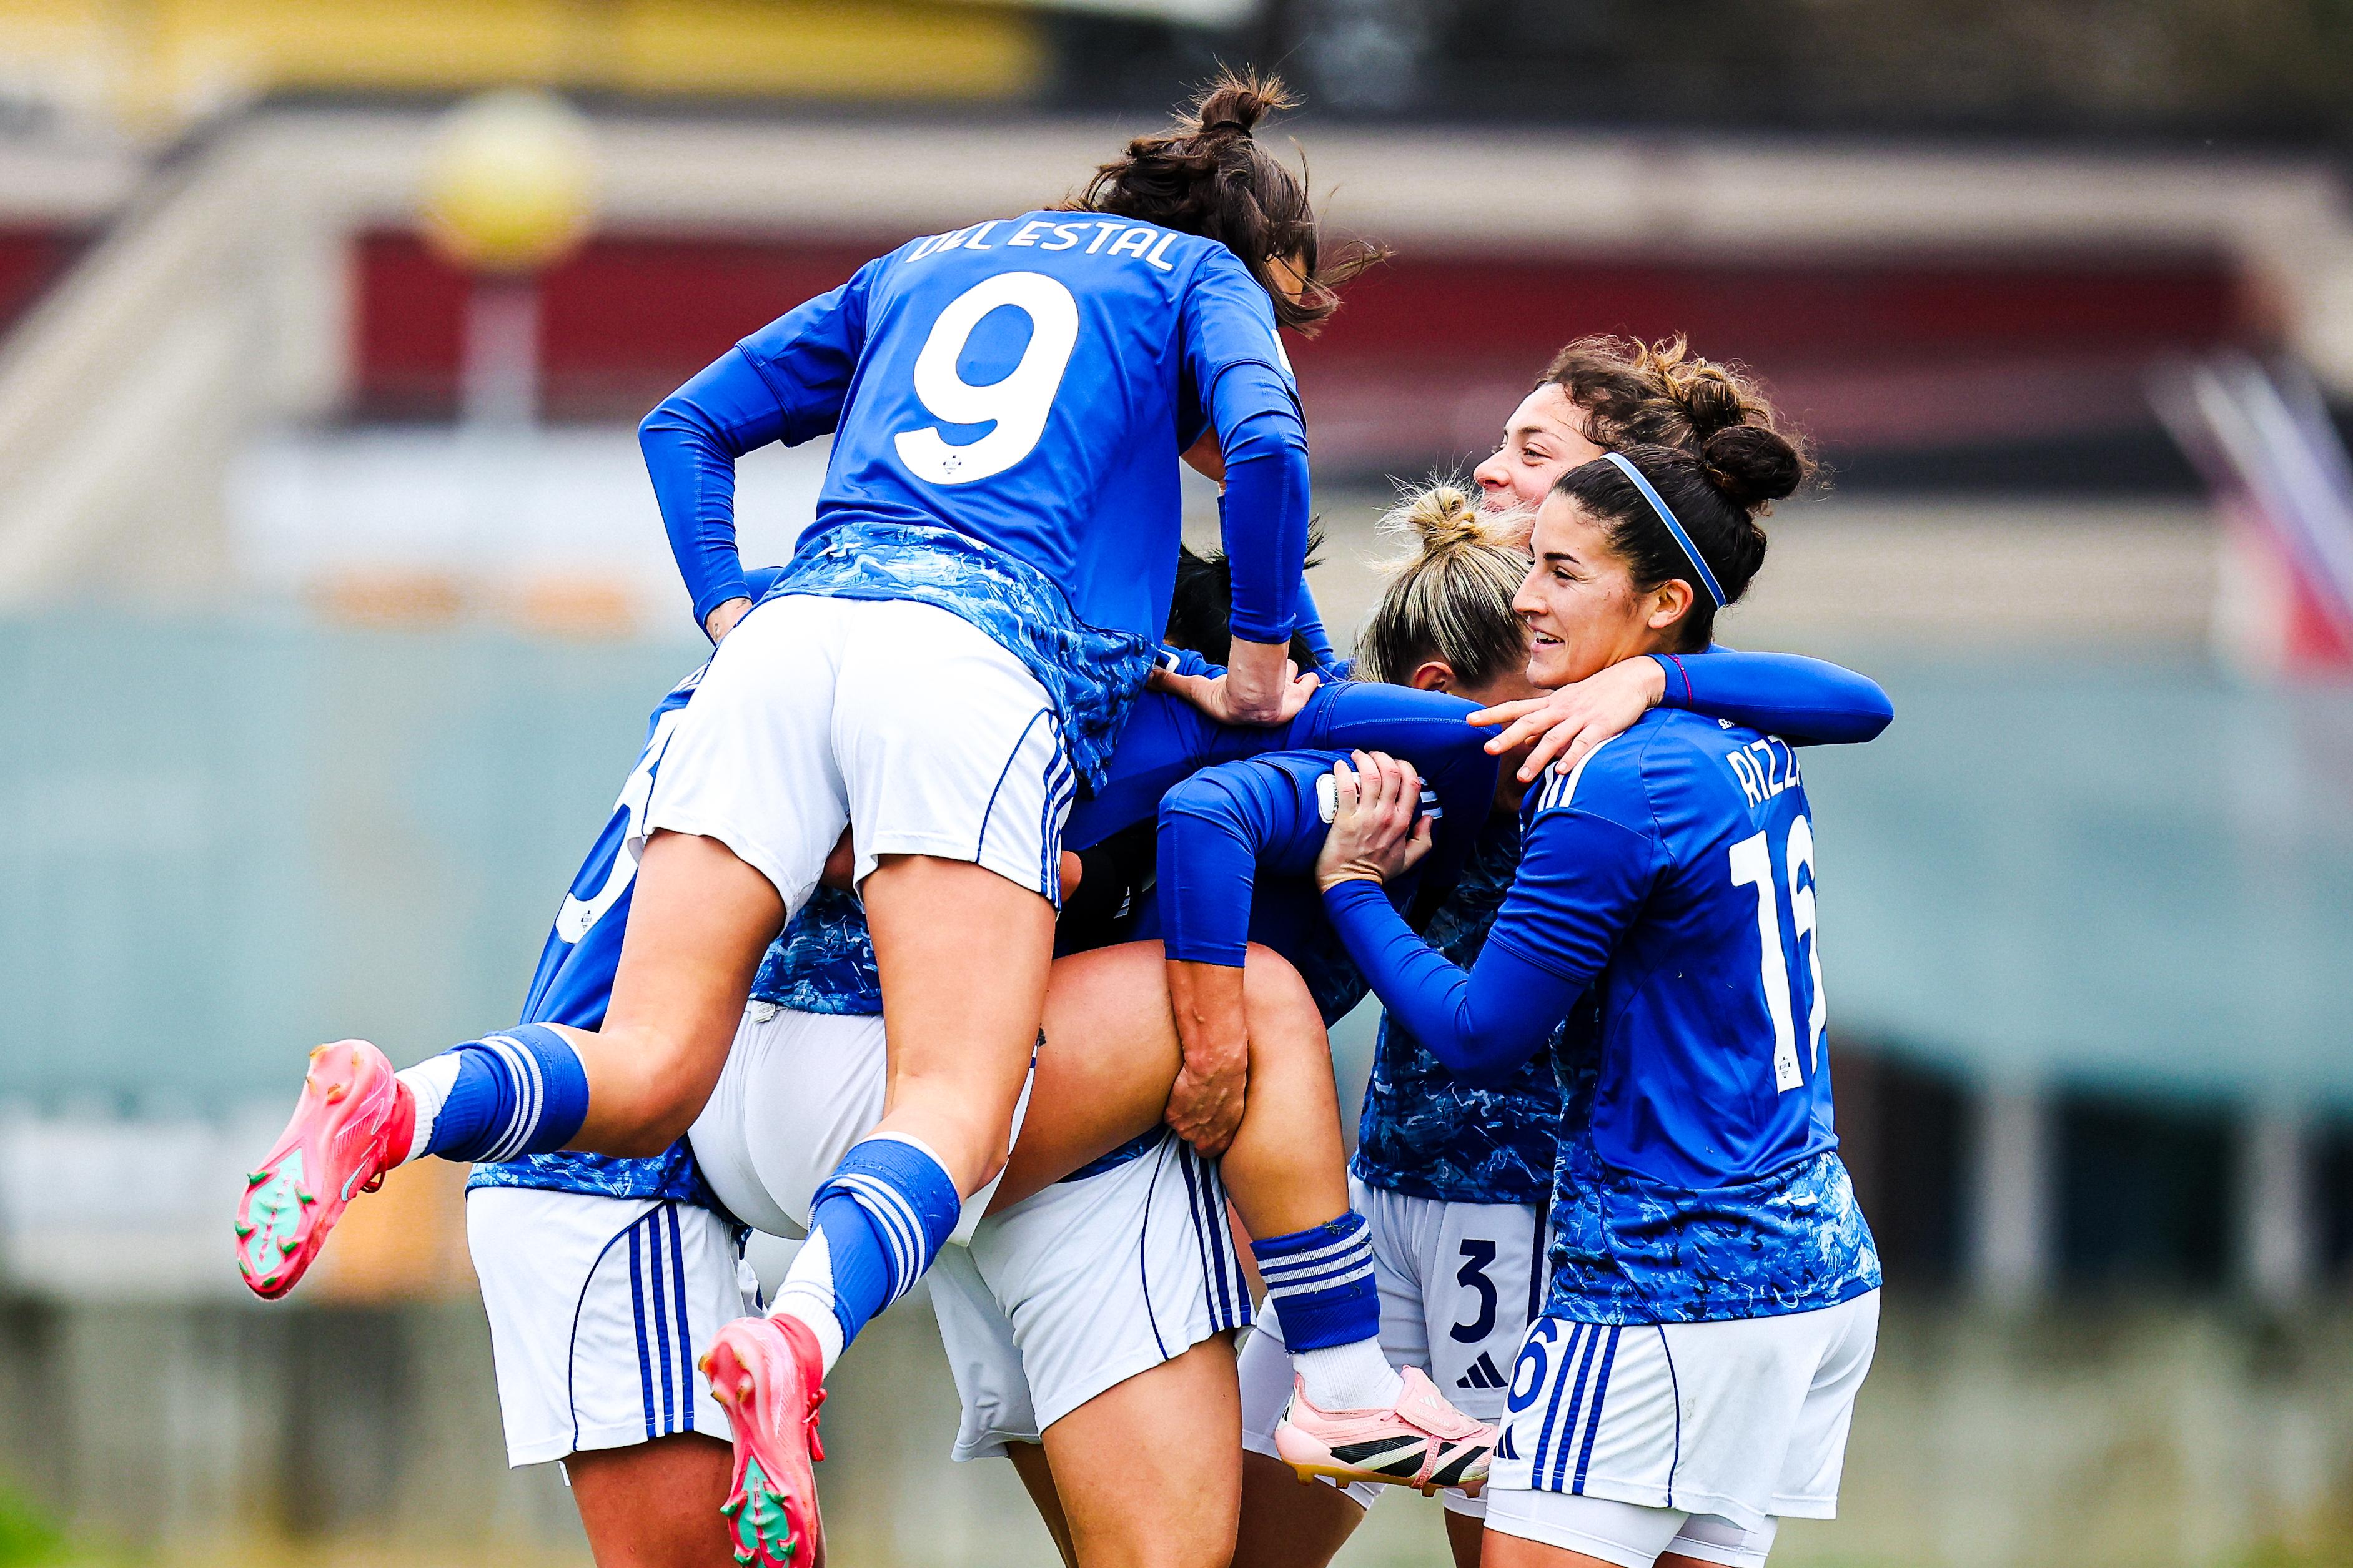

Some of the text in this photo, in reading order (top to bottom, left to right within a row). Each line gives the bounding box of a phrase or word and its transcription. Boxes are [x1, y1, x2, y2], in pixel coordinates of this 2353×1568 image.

[904, 220, 1178, 272] DEL ESTAL
[894, 271, 1079, 485] 9
[1726, 734, 1801, 808] RIZZ
[1450, 1239, 1497, 1344] 3
[1507, 1316, 1558, 1413] 6
[1415, 1408, 1450, 1427] BECKHAM
